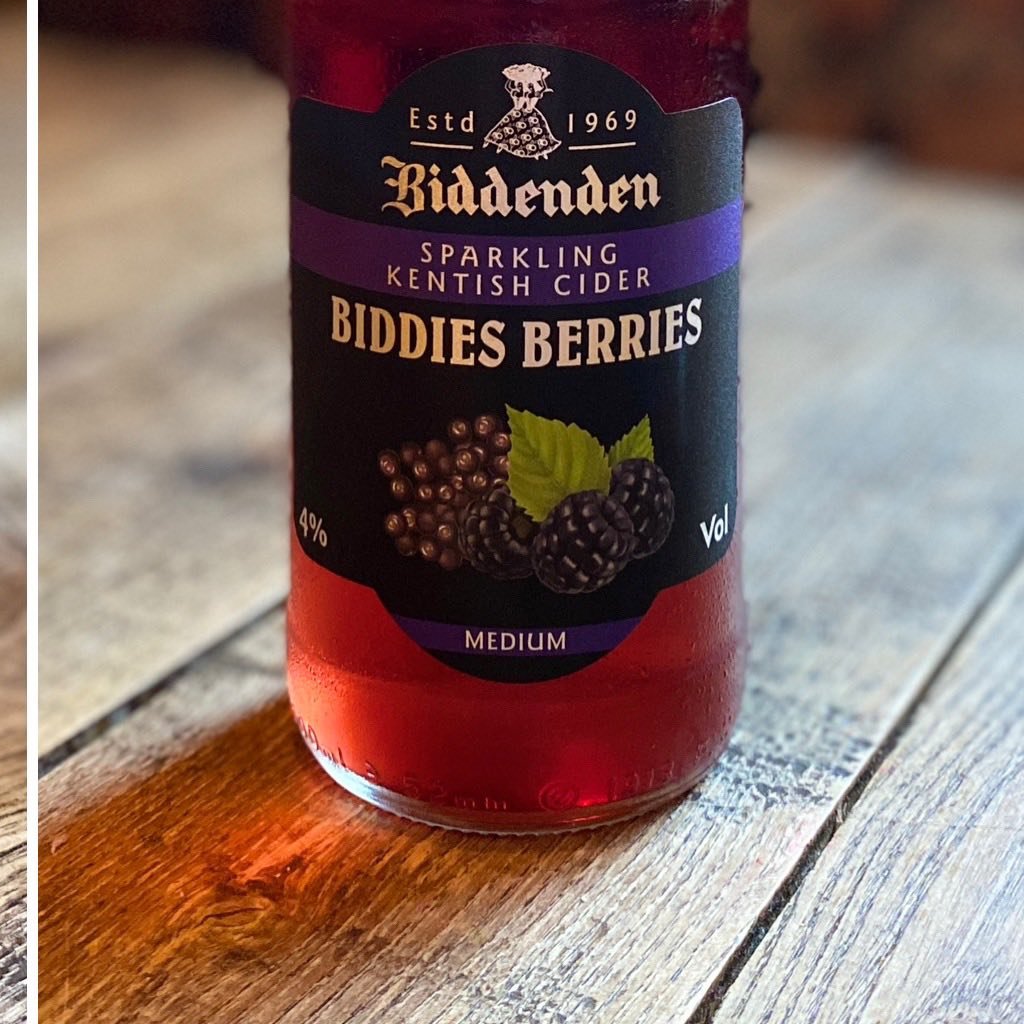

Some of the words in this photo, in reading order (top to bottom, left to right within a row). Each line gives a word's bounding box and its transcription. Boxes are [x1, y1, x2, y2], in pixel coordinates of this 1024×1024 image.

[410, 107, 474, 133] Estd
[568, 109, 637, 134] 1969
[380, 155, 662, 219] Biddenden
[420, 242, 618, 268] SPARKLING
[387, 265, 531, 297] KENTISH
[554, 267, 650, 297] CIDER
[331, 295, 506, 369] BIDDIES
[522, 297, 703, 369] BERRIES
[299, 506, 328, 548] 4%
[699, 503, 729, 549] Vol
[465, 629, 567, 651] MEDIUM
